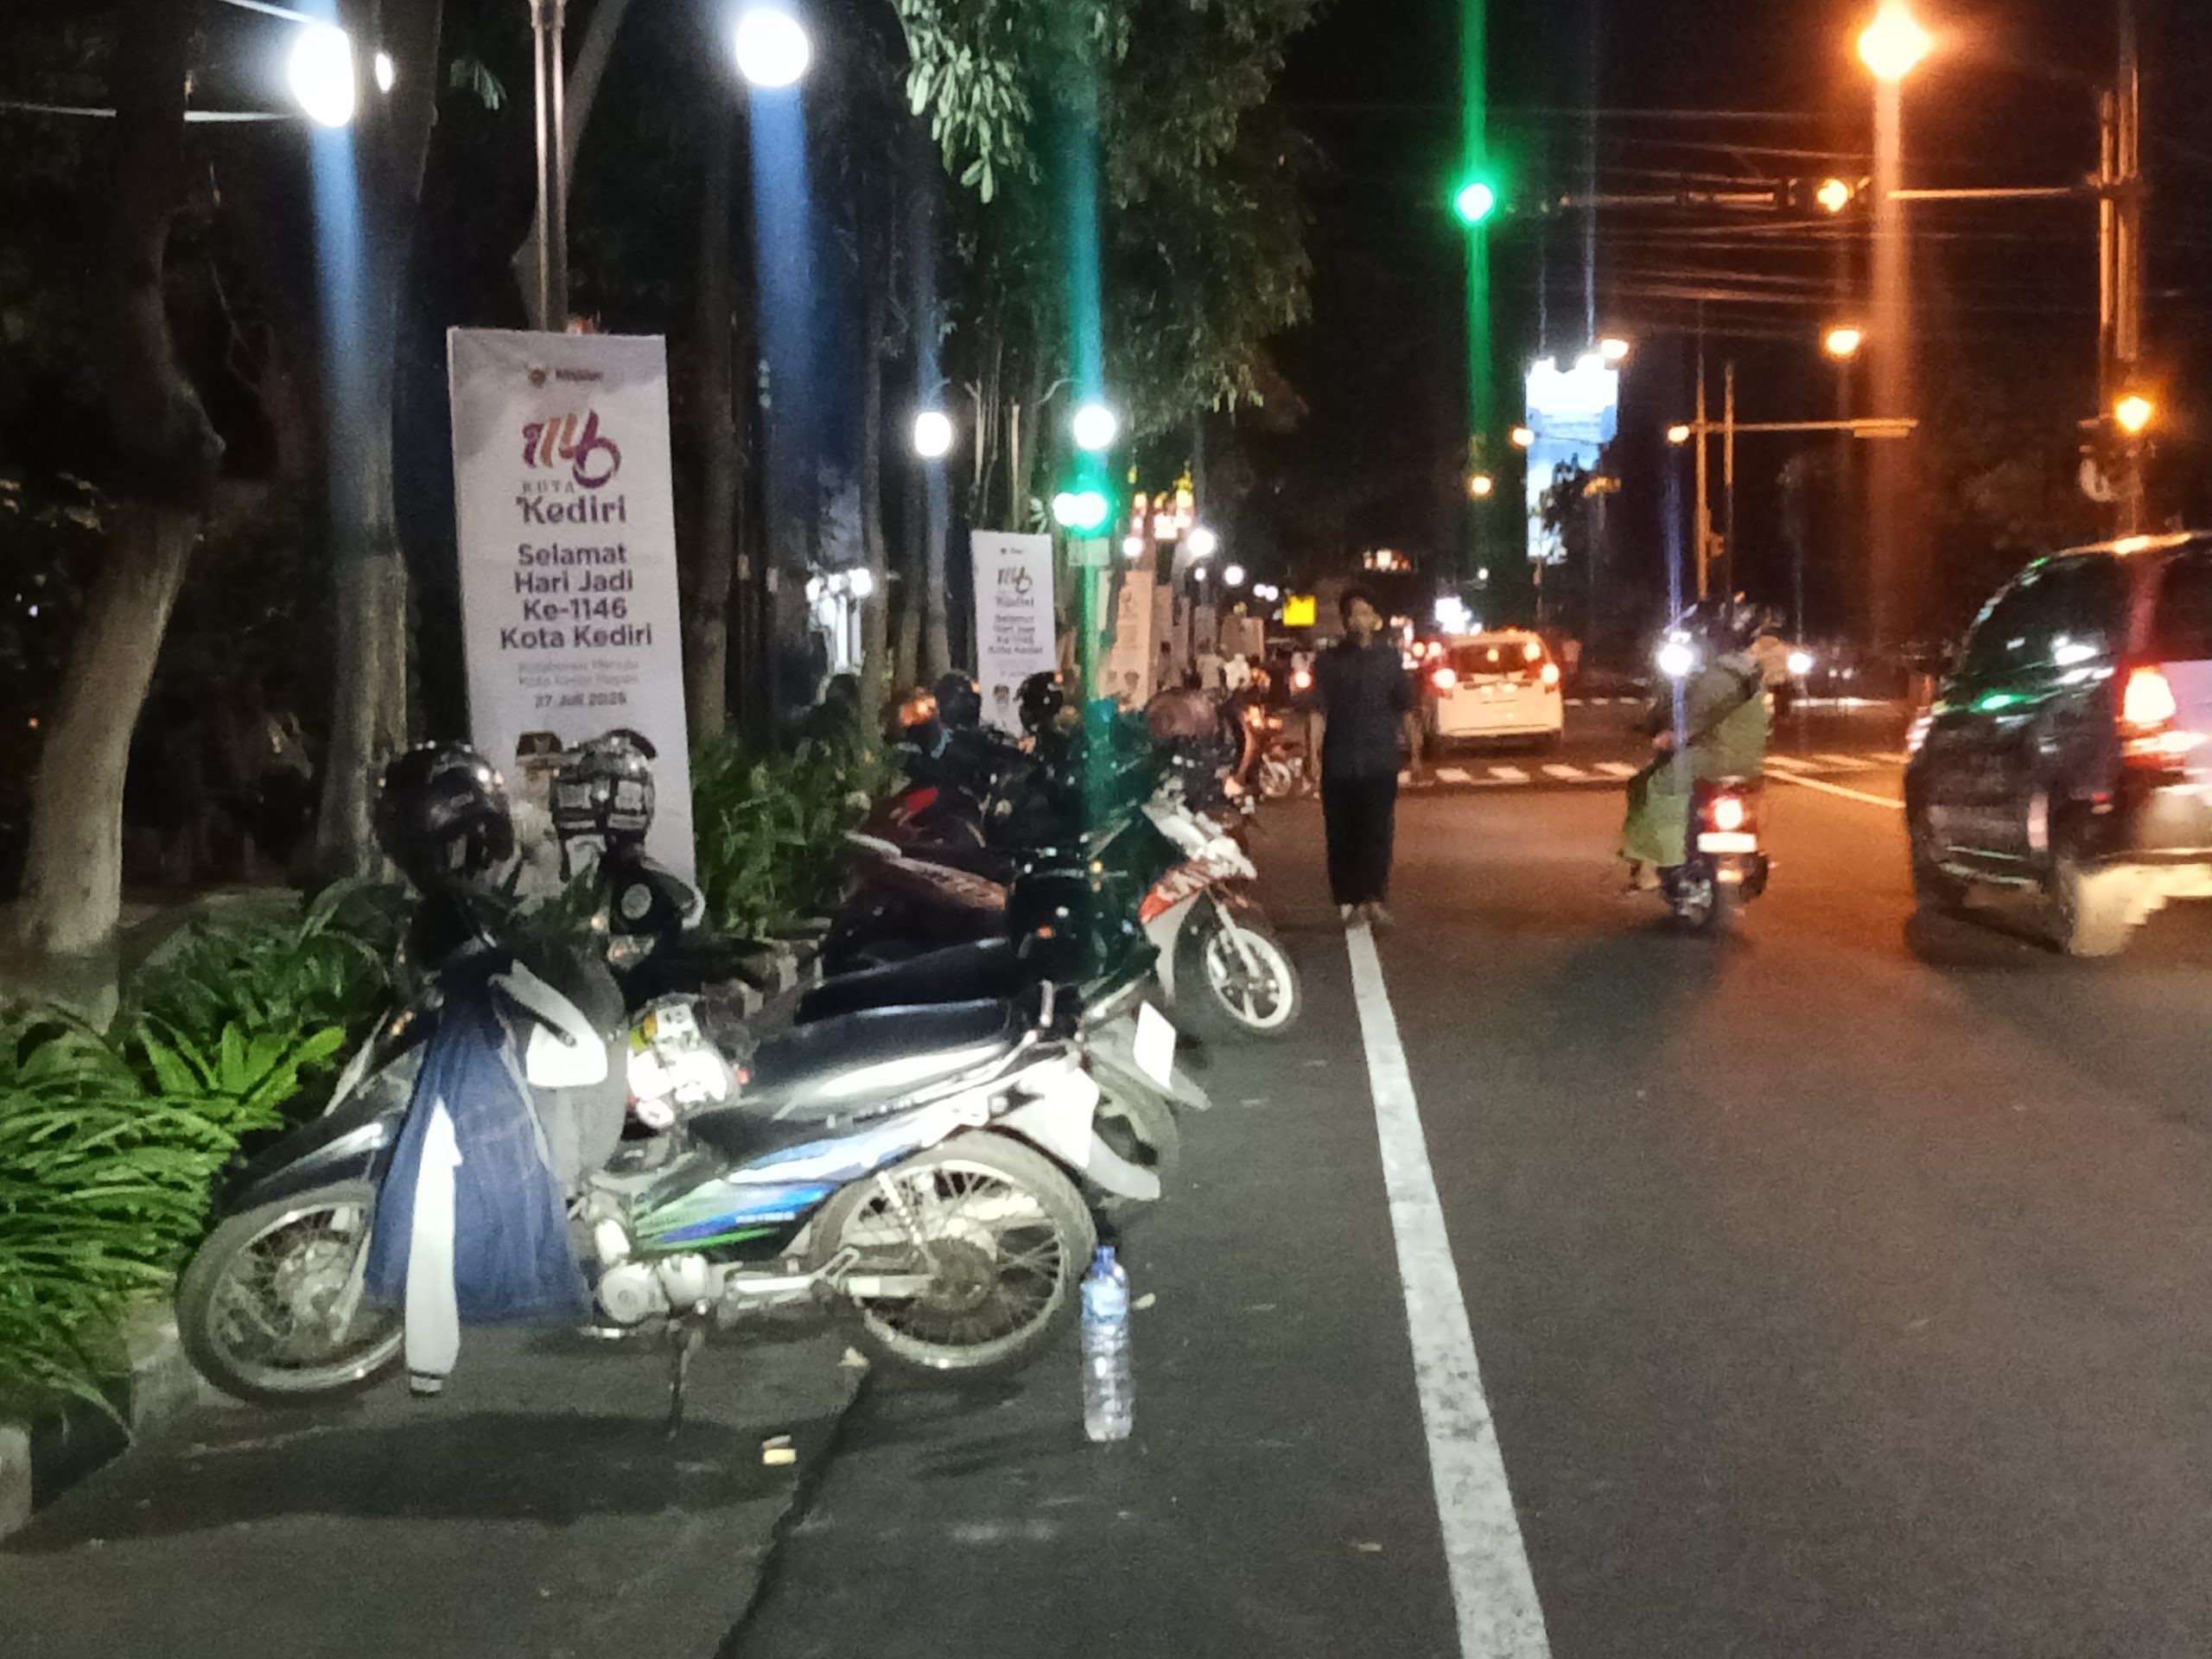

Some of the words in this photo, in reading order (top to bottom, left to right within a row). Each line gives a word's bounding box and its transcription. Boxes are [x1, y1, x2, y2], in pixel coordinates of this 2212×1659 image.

[516, 494, 626, 524] Kediri
[518, 543, 626, 566] Selamat
[514, 570, 569, 594] Hari
[578, 569, 633, 593] Jadi
[523, 596, 627, 621] Ke-1146
[500, 626, 565, 650] Kota
[574, 622, 652, 648] Kediri
